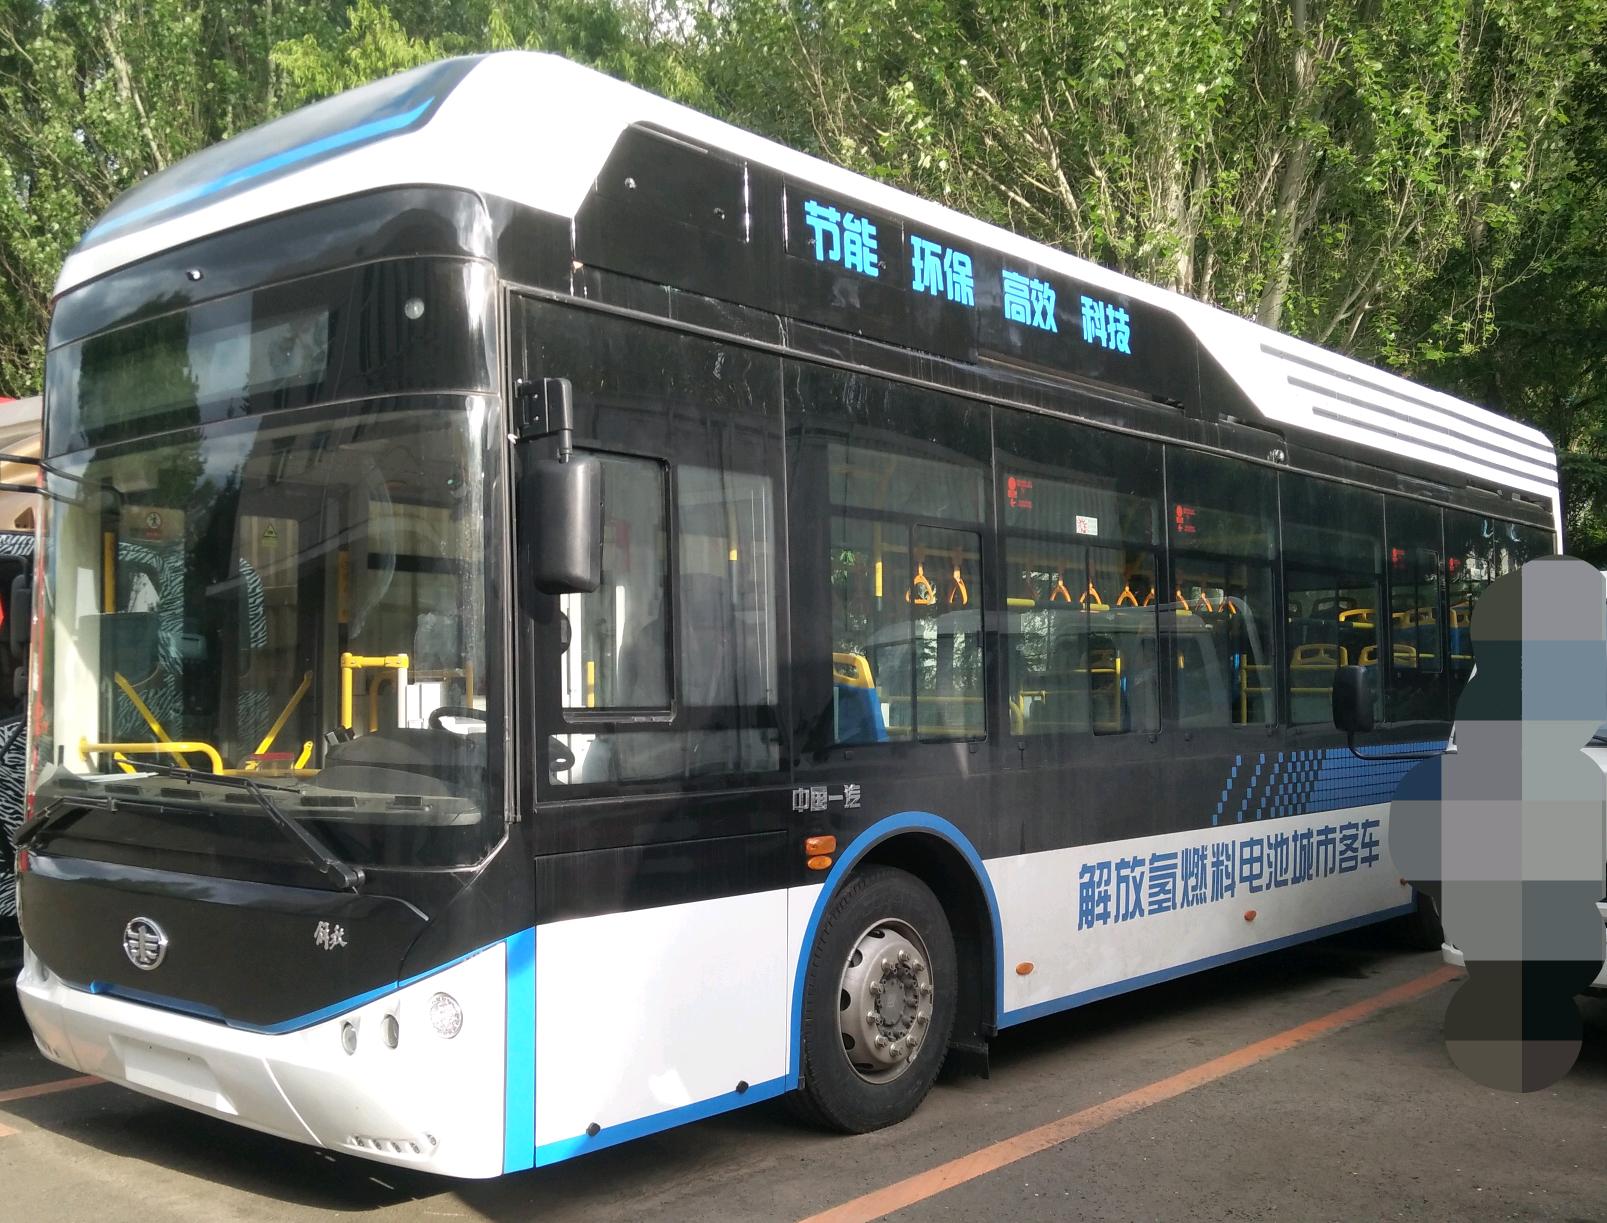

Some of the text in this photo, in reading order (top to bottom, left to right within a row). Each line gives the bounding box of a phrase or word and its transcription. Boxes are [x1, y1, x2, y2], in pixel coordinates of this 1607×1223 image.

[805, 200, 1132, 355] 节能 环保 高效 科技
[792, 784, 861, 812] 中国一汽
[1078, 819, 1380, 931] 解放氢燃料电池城市客车
